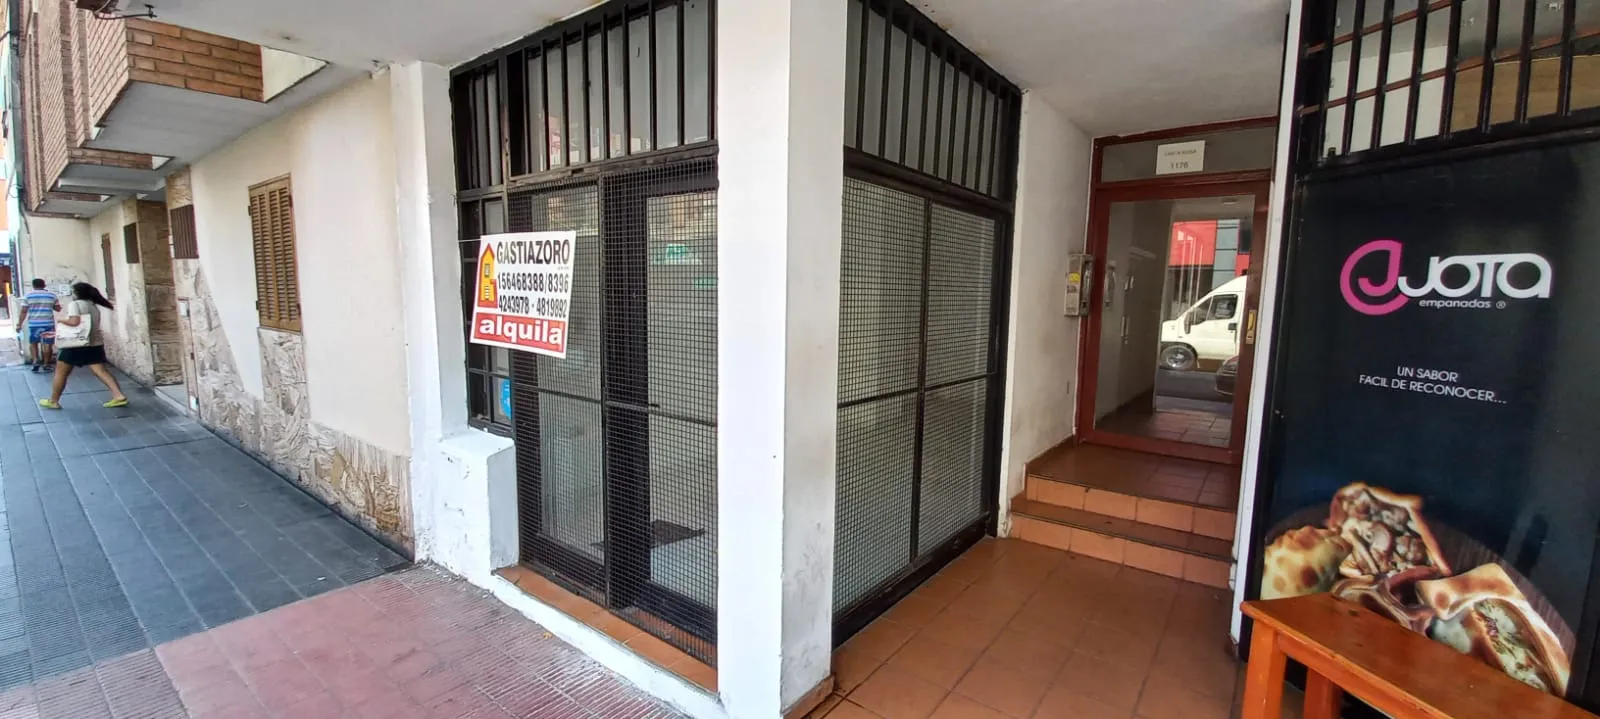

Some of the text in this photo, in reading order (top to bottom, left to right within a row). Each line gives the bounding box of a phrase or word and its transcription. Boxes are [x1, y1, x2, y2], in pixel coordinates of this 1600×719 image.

[497, 239, 570, 264] GASTIAZORO
[497, 271, 570, 294] 156468388/8396
[499, 295, 530, 314] 4243978
[1419, 299, 1492, 309] empanadas
[479, 315, 563, 345] alquila
[1397, 366, 1459, 383] UN SABOR
[1359, 374, 1508, 404] FACIL DE RECONOCER...
